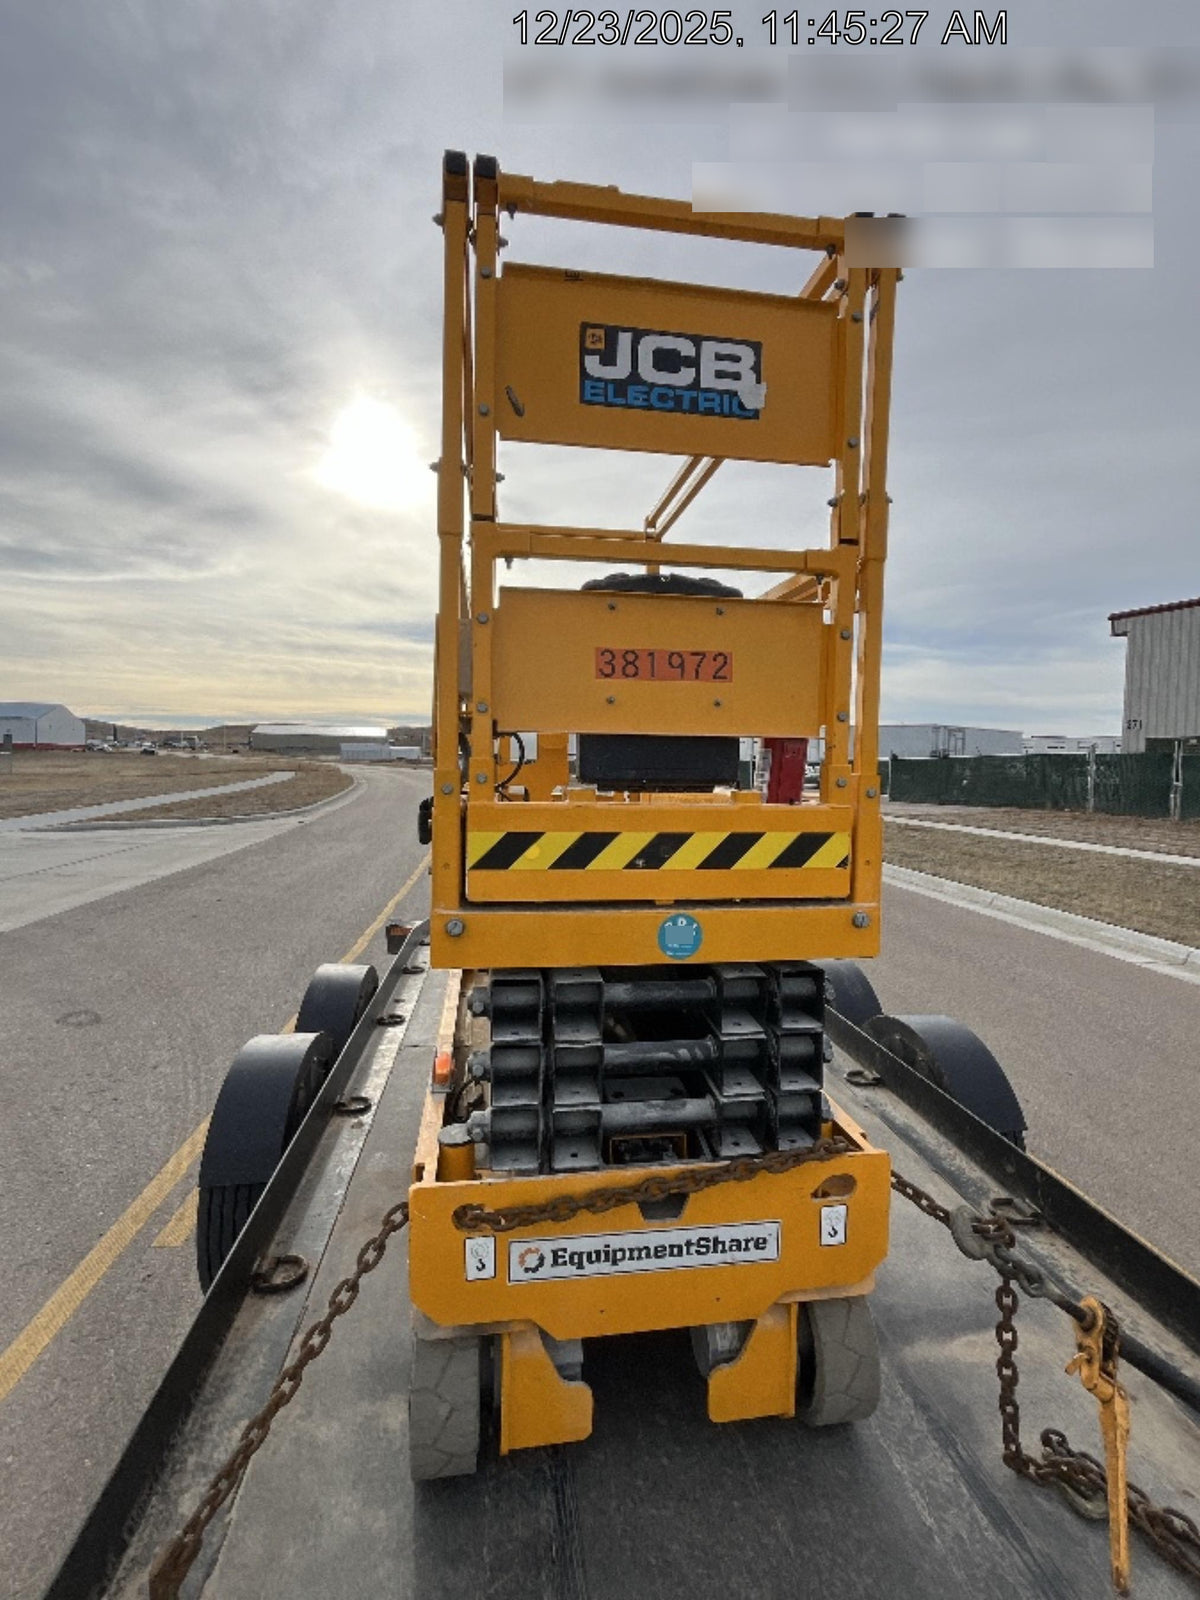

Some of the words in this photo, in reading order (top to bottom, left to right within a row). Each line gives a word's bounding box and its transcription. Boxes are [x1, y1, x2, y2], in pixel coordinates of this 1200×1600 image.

[584, 331, 757, 391] JCB
[598, 648, 728, 680] 381972
[551, 1236, 768, 1270] EquipmentShare
